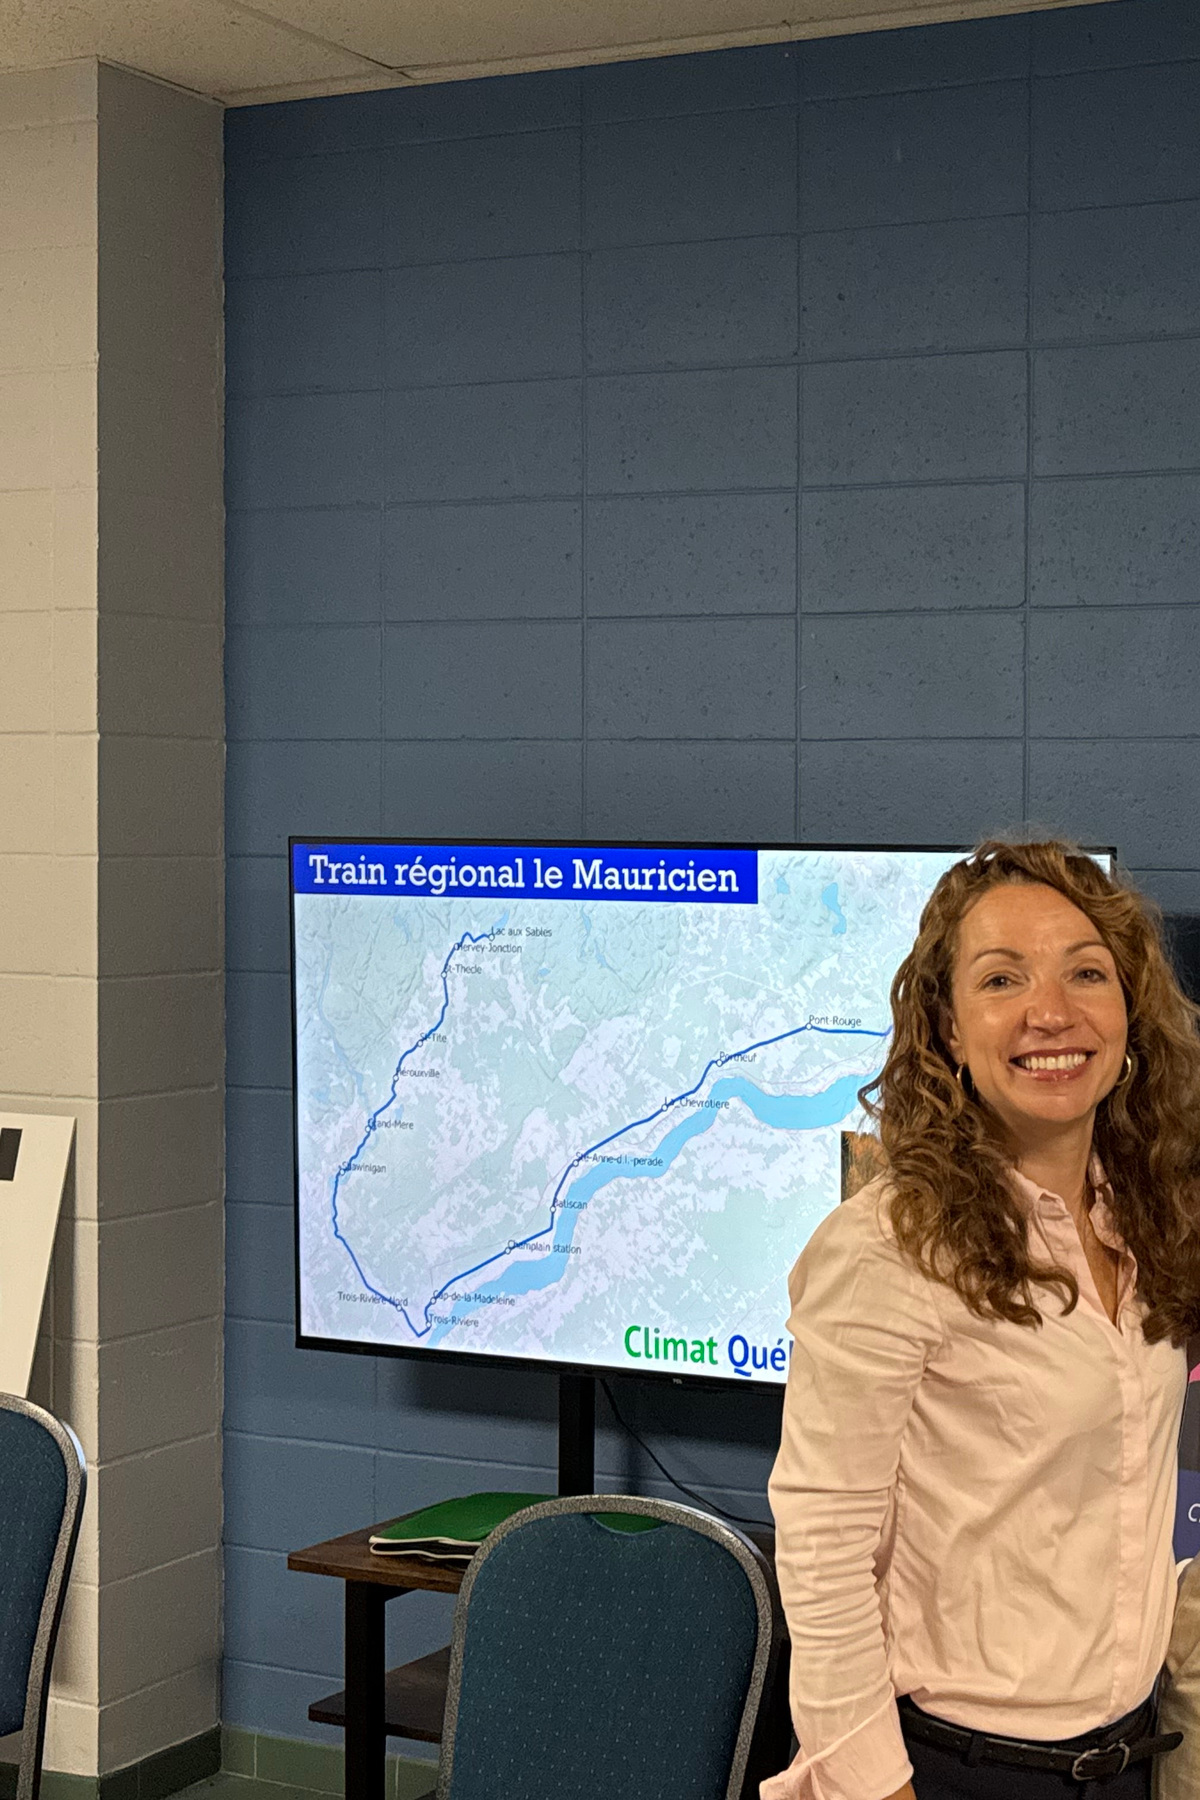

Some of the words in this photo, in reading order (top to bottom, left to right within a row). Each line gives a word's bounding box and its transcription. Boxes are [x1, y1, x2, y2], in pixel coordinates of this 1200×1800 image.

[309, 854, 387, 885] Train
[394, 855, 525, 895] régional
[533, 857, 564, 889] le
[572, 859, 739, 892] Mauricien
[491, 926, 506, 937] Lac
[508, 928, 522, 937] aux
[525, 926, 552, 938] Sables
[809, 1014, 862, 1029] Pont-Rouge
[419, 1032, 448, 1044] S-Tite
[719, 1051, 758, 1063] Potneuf
[397, 1066, 441, 1079] érouxville
[367, 1118, 414, 1131] Gand-Mere
[341, 1161, 387, 1175] Sawinigan
[553, 1243, 582, 1255] station
[624, 1325, 718, 1365] Climat
